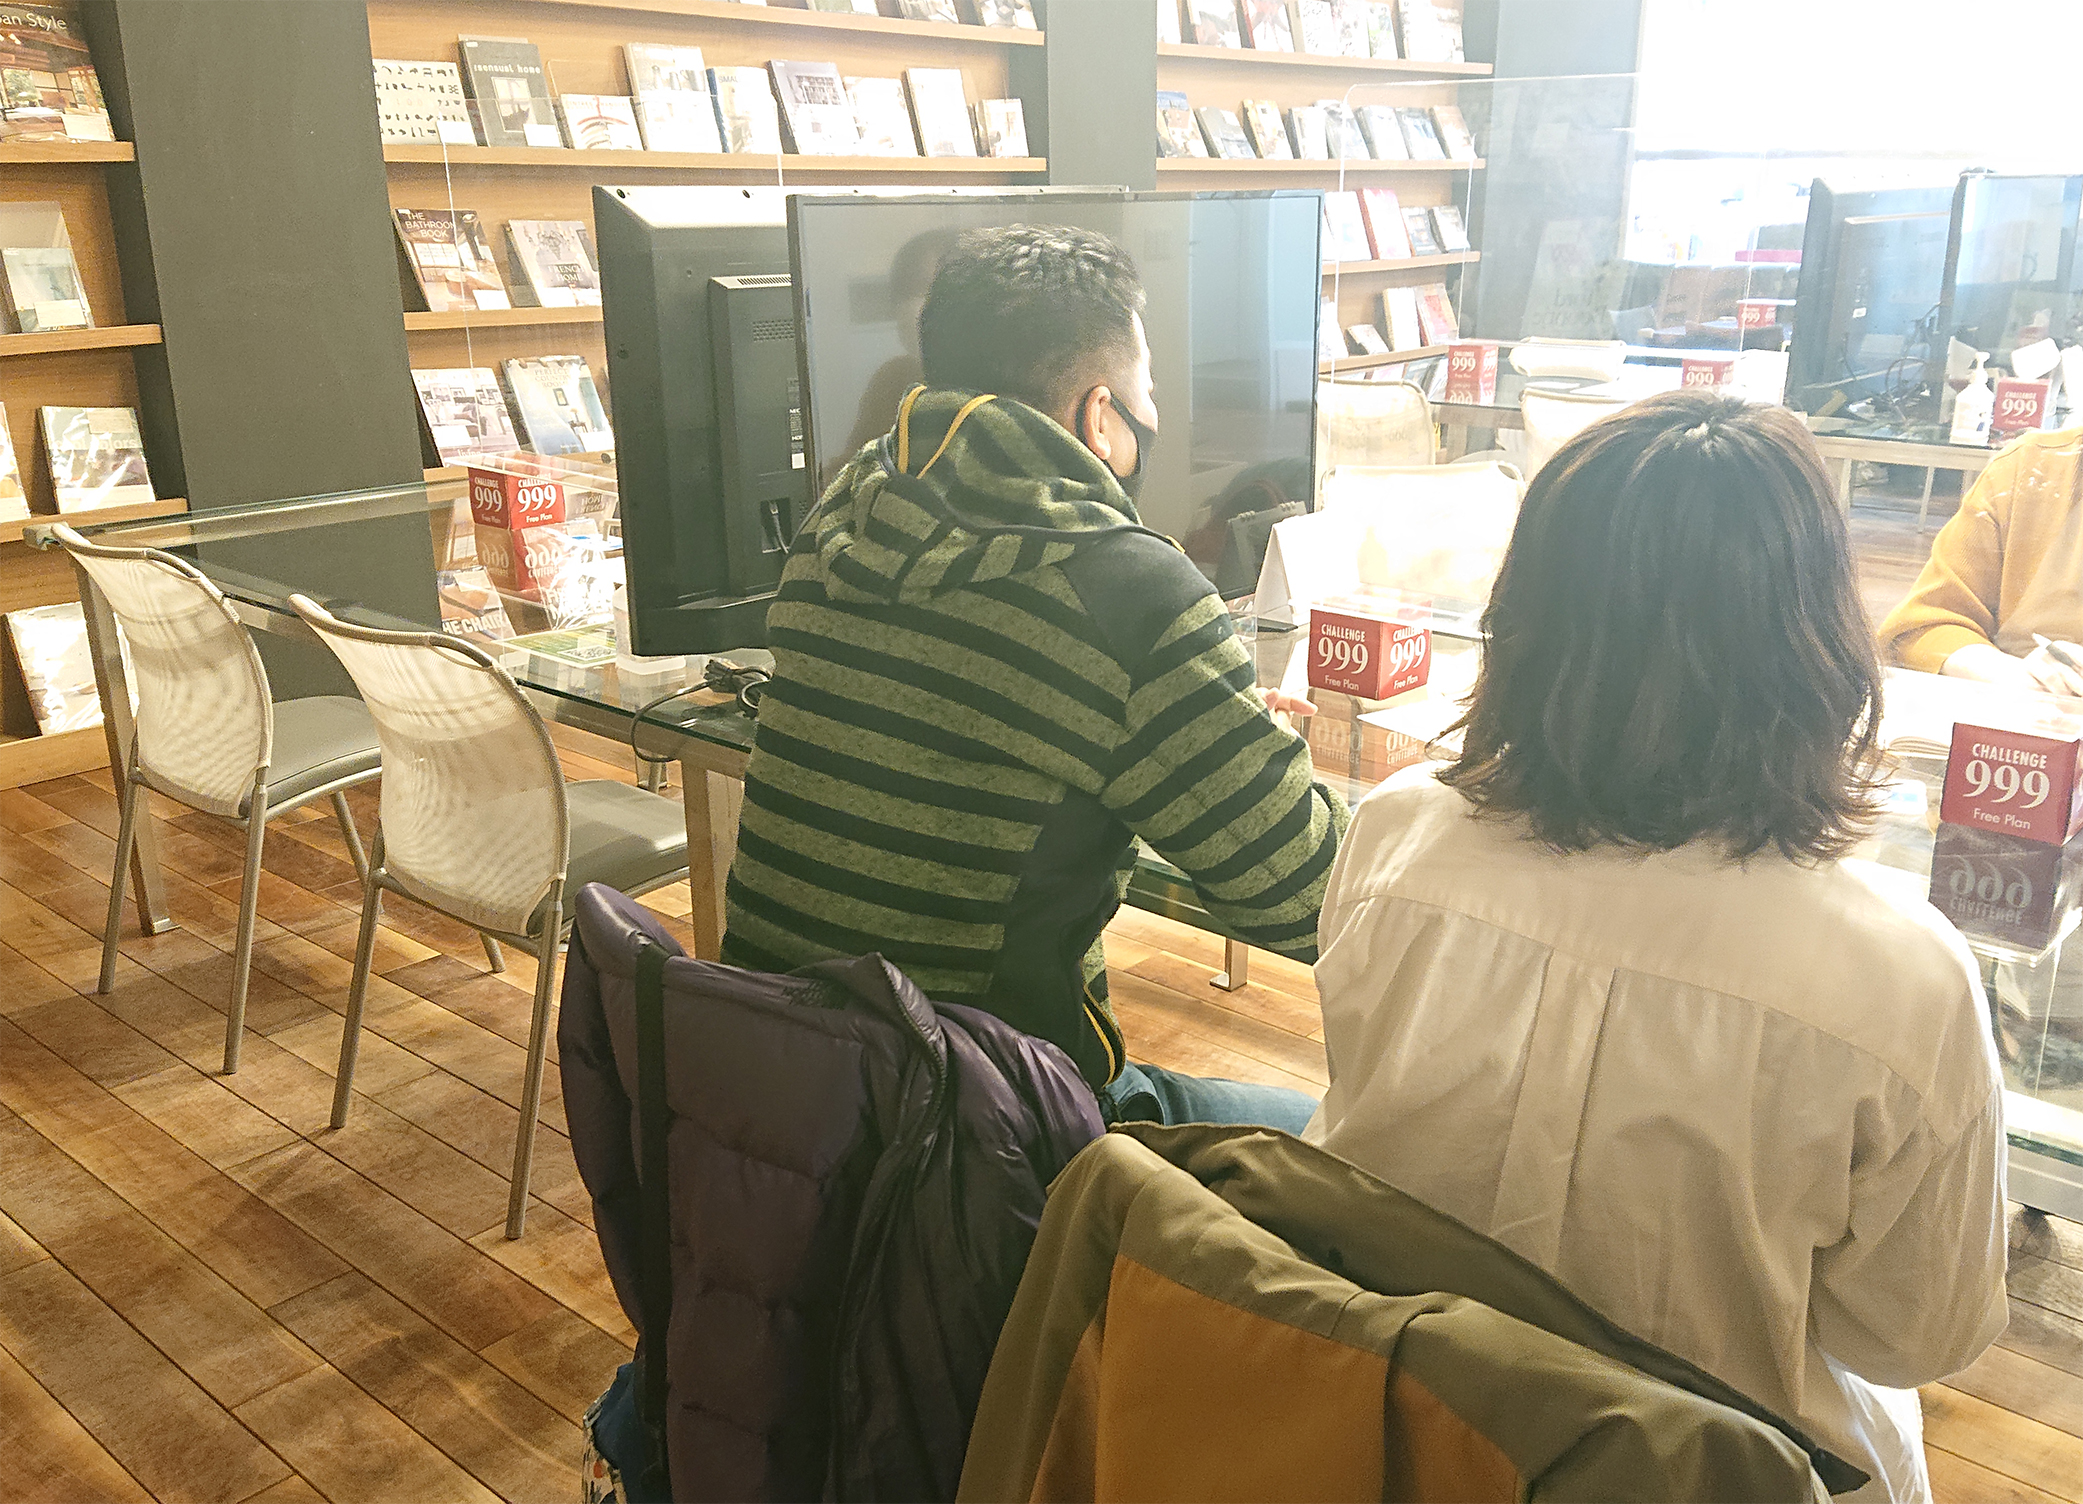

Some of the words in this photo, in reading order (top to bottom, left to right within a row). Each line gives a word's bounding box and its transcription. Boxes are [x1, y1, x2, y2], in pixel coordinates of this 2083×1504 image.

[0, 14, 22, 26] an
[26, 13, 67, 31] Style
[407, 212, 426, 221] THE
[420, 229, 449, 238] BOOK
[1451, 356, 1476, 372] 999
[1685, 371, 1715, 387] 999
[2001, 398, 2038, 418] 999
[91, 439, 138, 452] olors
[475, 477, 499, 489] CHALLENGE
[475, 486, 503, 513] 999
[518, 485, 557, 513] 999
[540, 513, 553, 521] Plan
[461, 613, 503, 633] CHAIR
[1321, 623, 1366, 643] CHALLENGE
[1317, 637, 1369, 675] 999
[1389, 634, 1426, 676] 999
[1324, 674, 1341, 687] Free
[1343, 678, 1360, 691] Plan
[1394, 679, 1406, 690] Free
[1406, 675, 1418, 685] Plan
[1972, 743, 2048, 769] CHALLENGE
[1962, 760, 2050, 809] 999
[1973, 807, 2000, 824] Free
[2004, 813, 2031, 830] Plan
